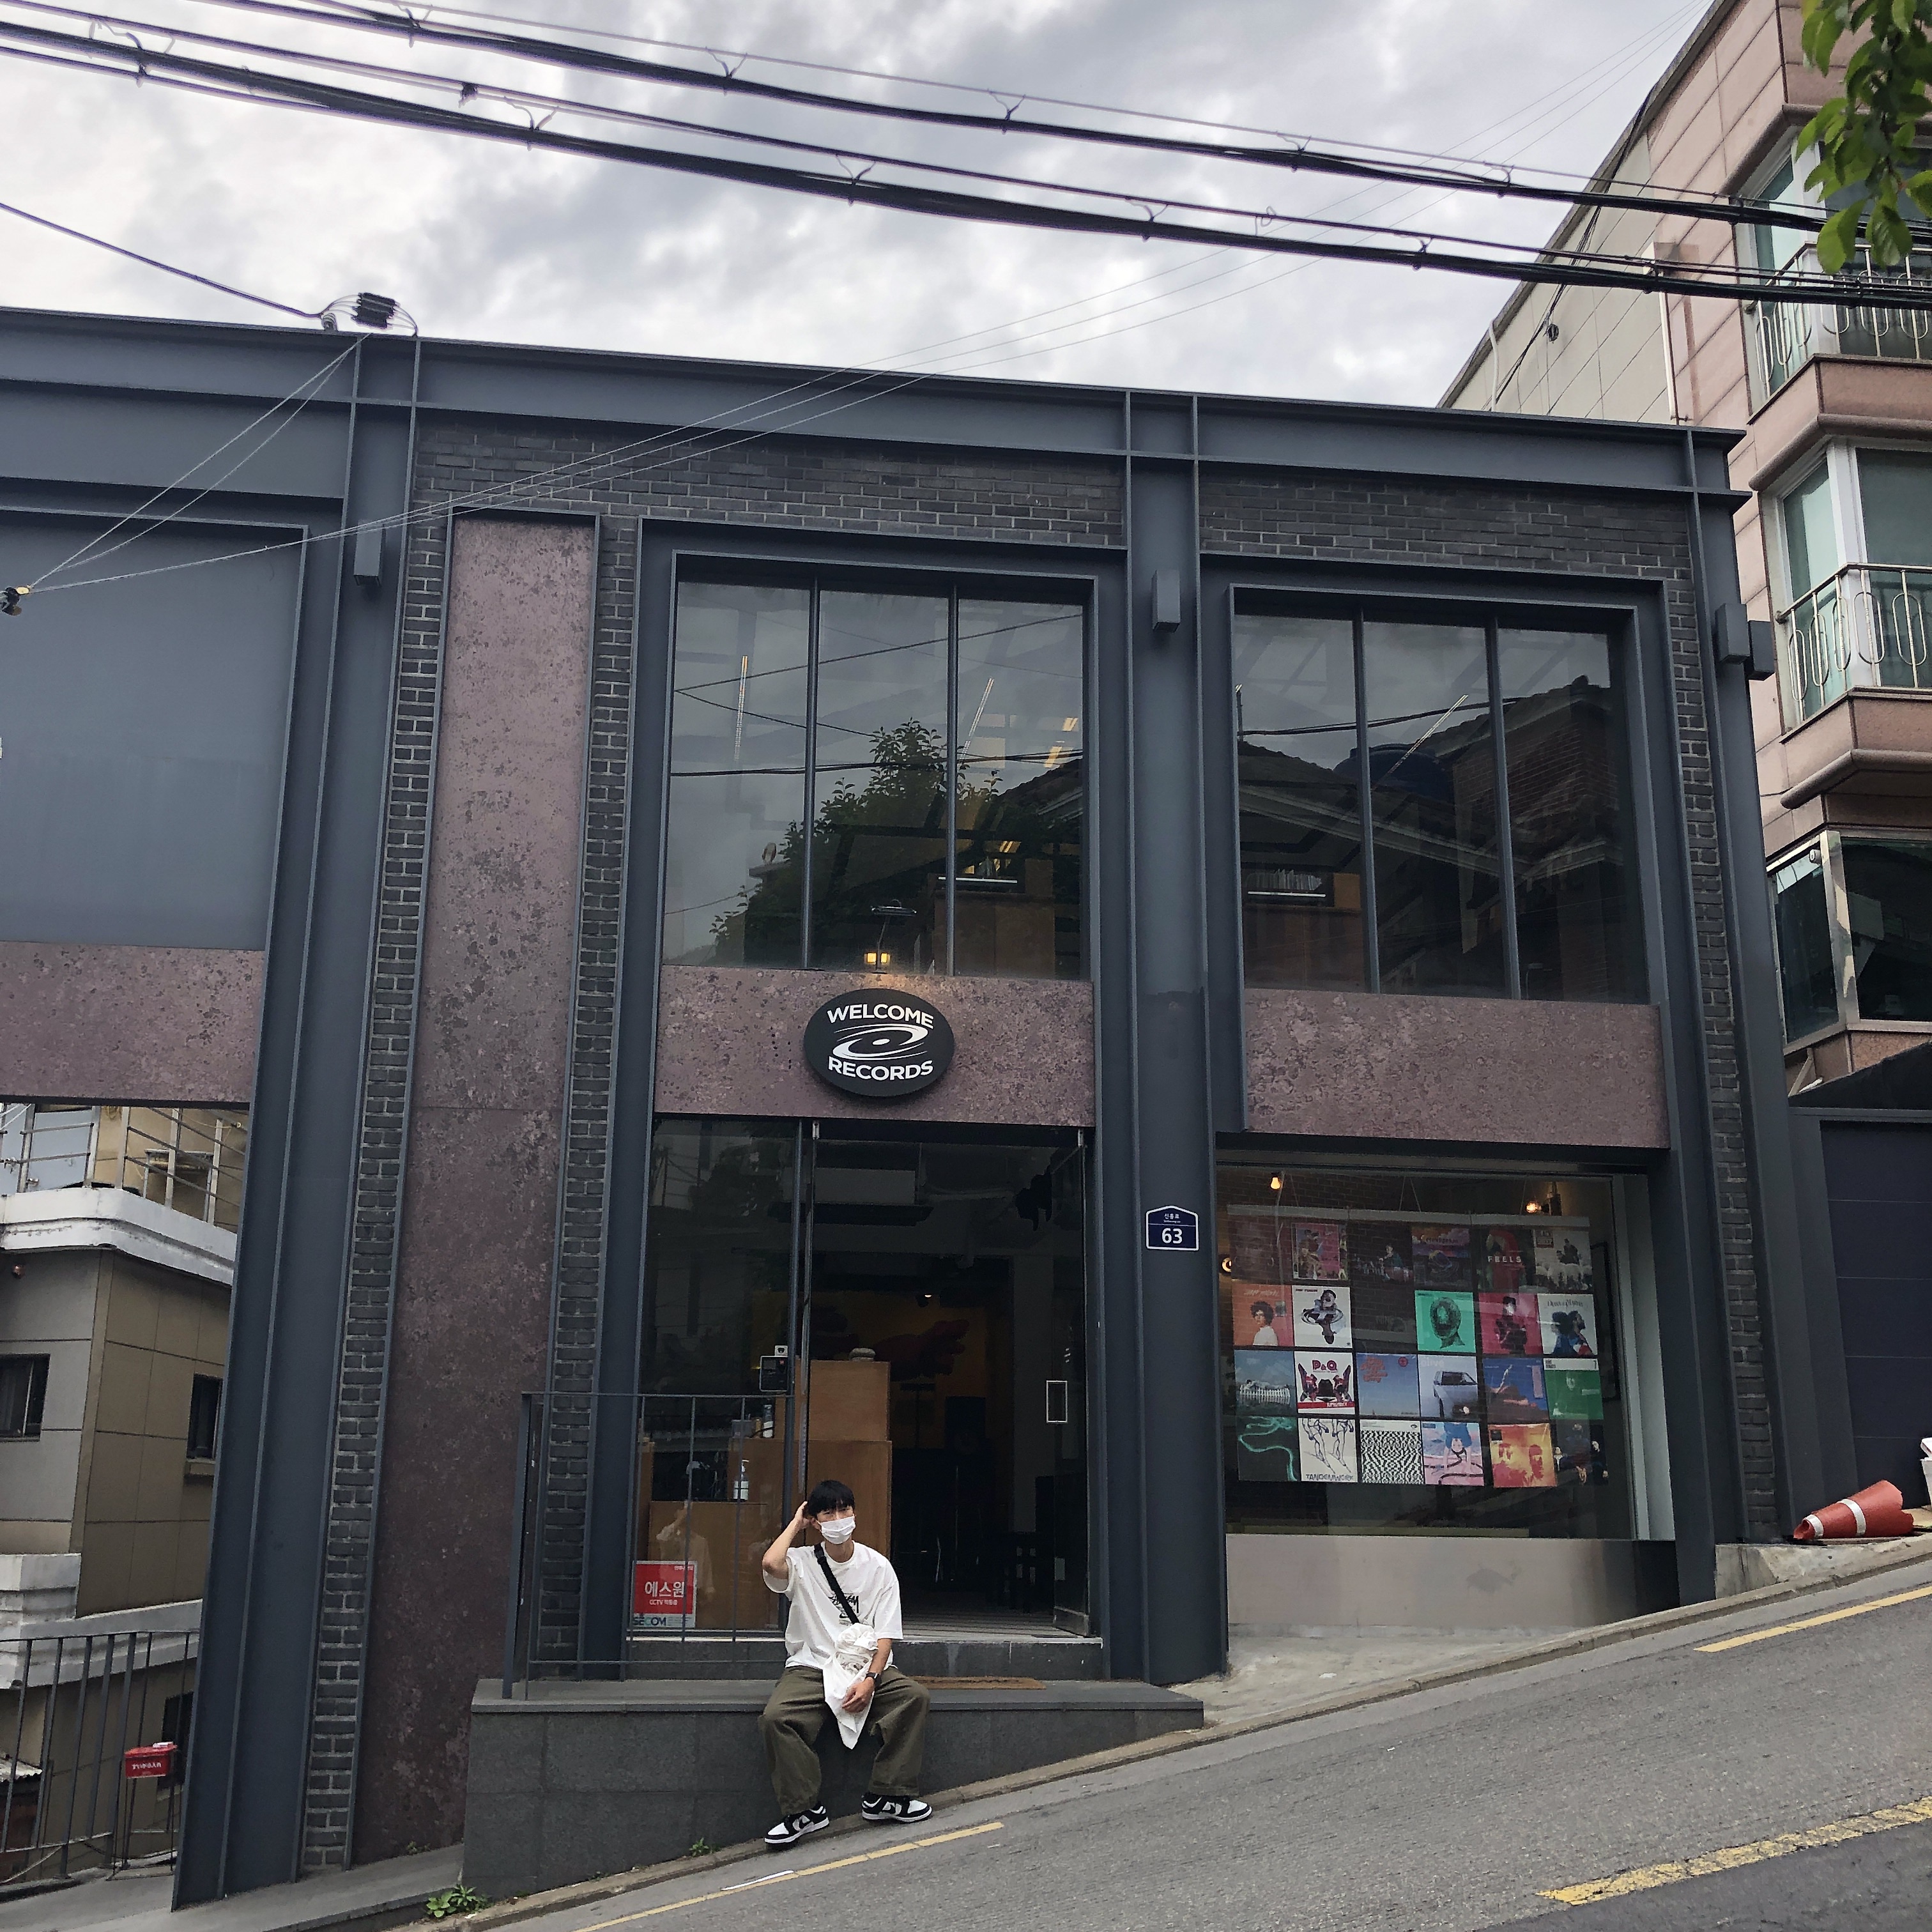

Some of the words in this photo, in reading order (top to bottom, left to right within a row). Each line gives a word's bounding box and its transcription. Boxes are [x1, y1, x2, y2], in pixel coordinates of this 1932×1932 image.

[827, 1004, 934, 1029] WELCOME
[828, 1056, 933, 1081] RECORDS
[1162, 1227, 1183, 1244] 63
[1312, 1360, 1337, 1371] P&Q
[645, 1581, 685, 1598] 에스원
